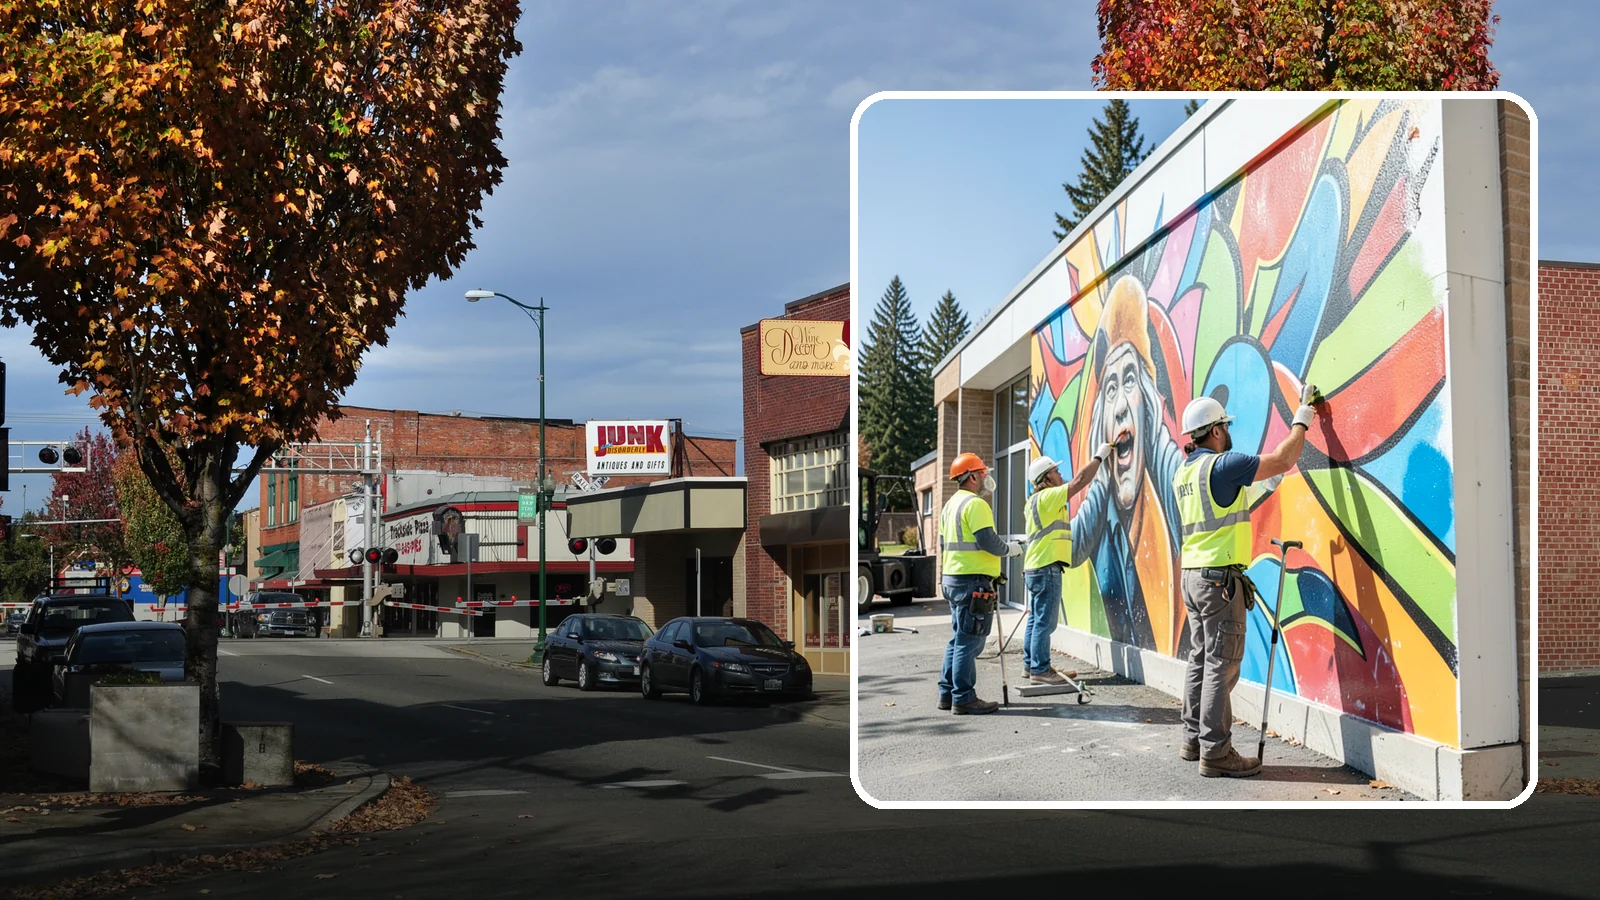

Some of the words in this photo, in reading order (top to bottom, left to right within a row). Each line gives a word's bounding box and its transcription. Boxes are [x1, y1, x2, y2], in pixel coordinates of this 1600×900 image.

[595, 425, 665, 457] JUNK
[607, 446, 646, 454] DISORDERLY
[597, 461, 628, 470] ANTIQUES
[631, 461, 644, 470] AND
[647, 461, 665, 470] GIFTS
[414, 519, 429, 535] Pizza
